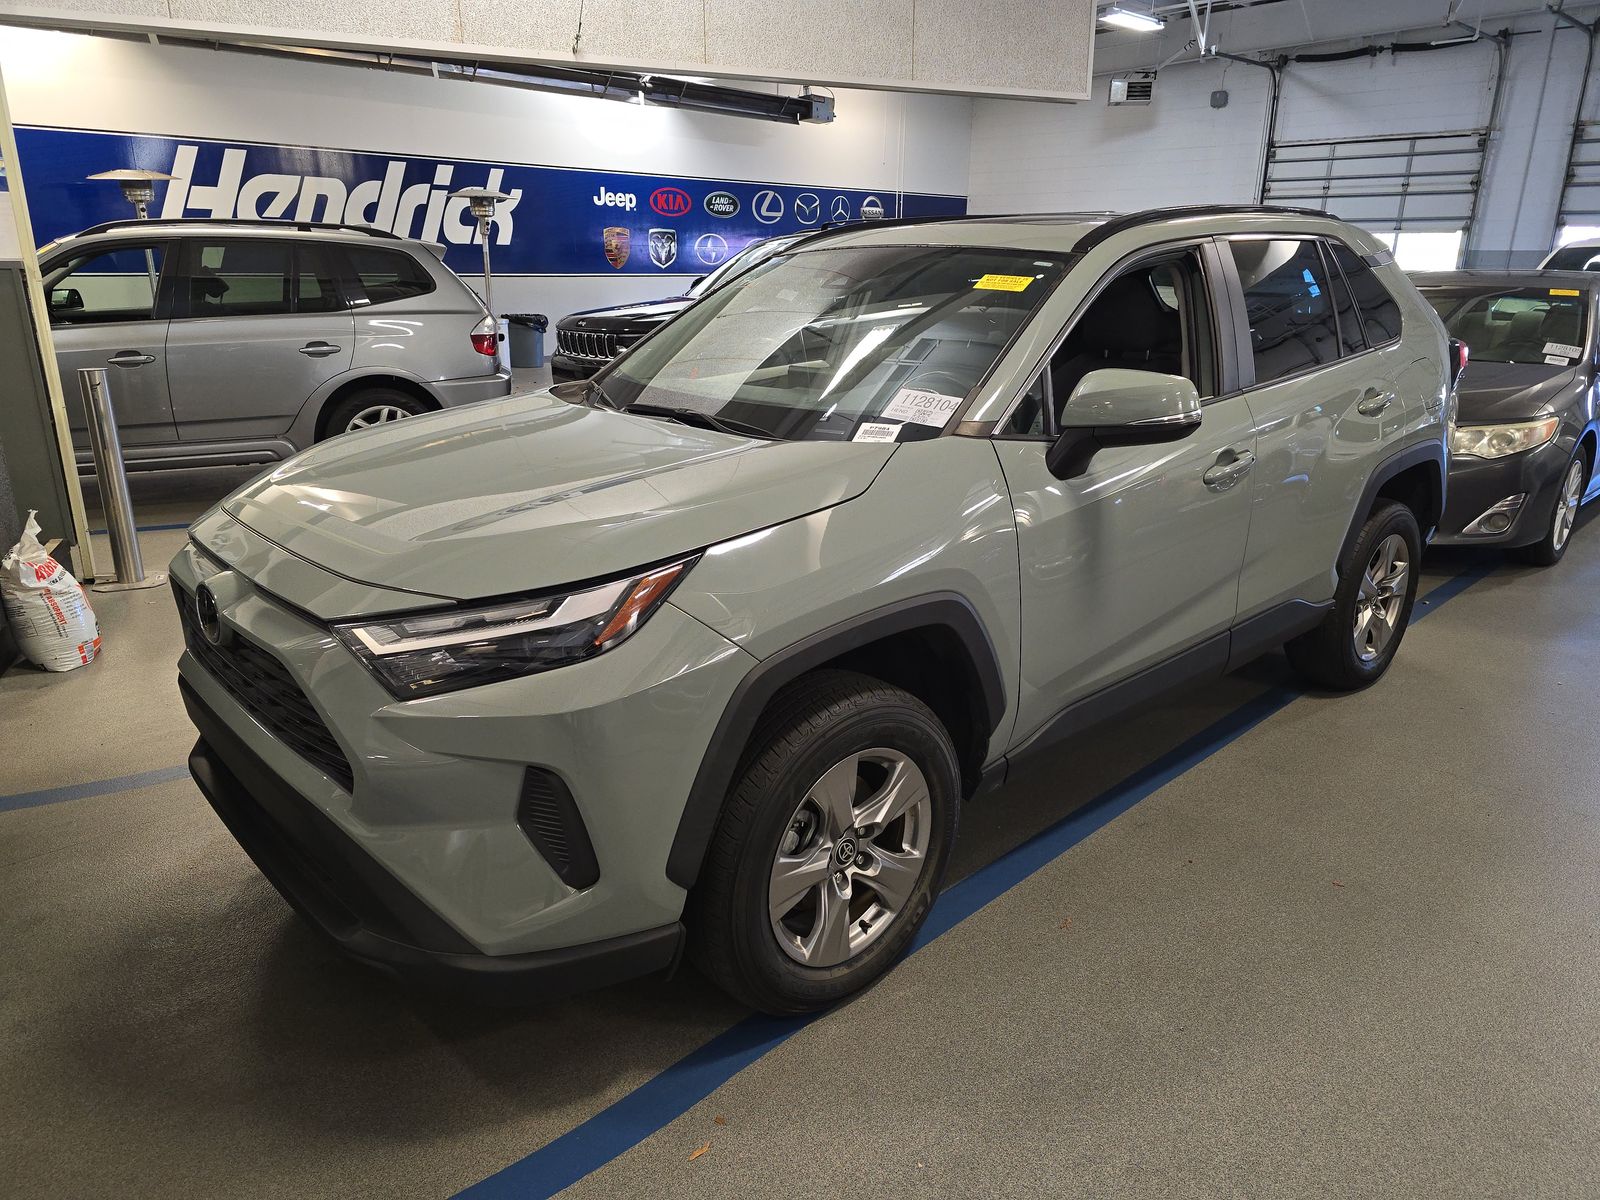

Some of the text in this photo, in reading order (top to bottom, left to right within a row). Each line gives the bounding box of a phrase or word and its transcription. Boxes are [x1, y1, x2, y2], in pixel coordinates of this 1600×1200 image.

[162, 145, 523, 245] Hendrick
[593, 186, 636, 211] Jeep
[656, 193, 686, 210] KIA
[711, 196, 729, 204] LAND
[713, 204, 734, 212] ROVER
[901, 393, 960, 412] 1128104
